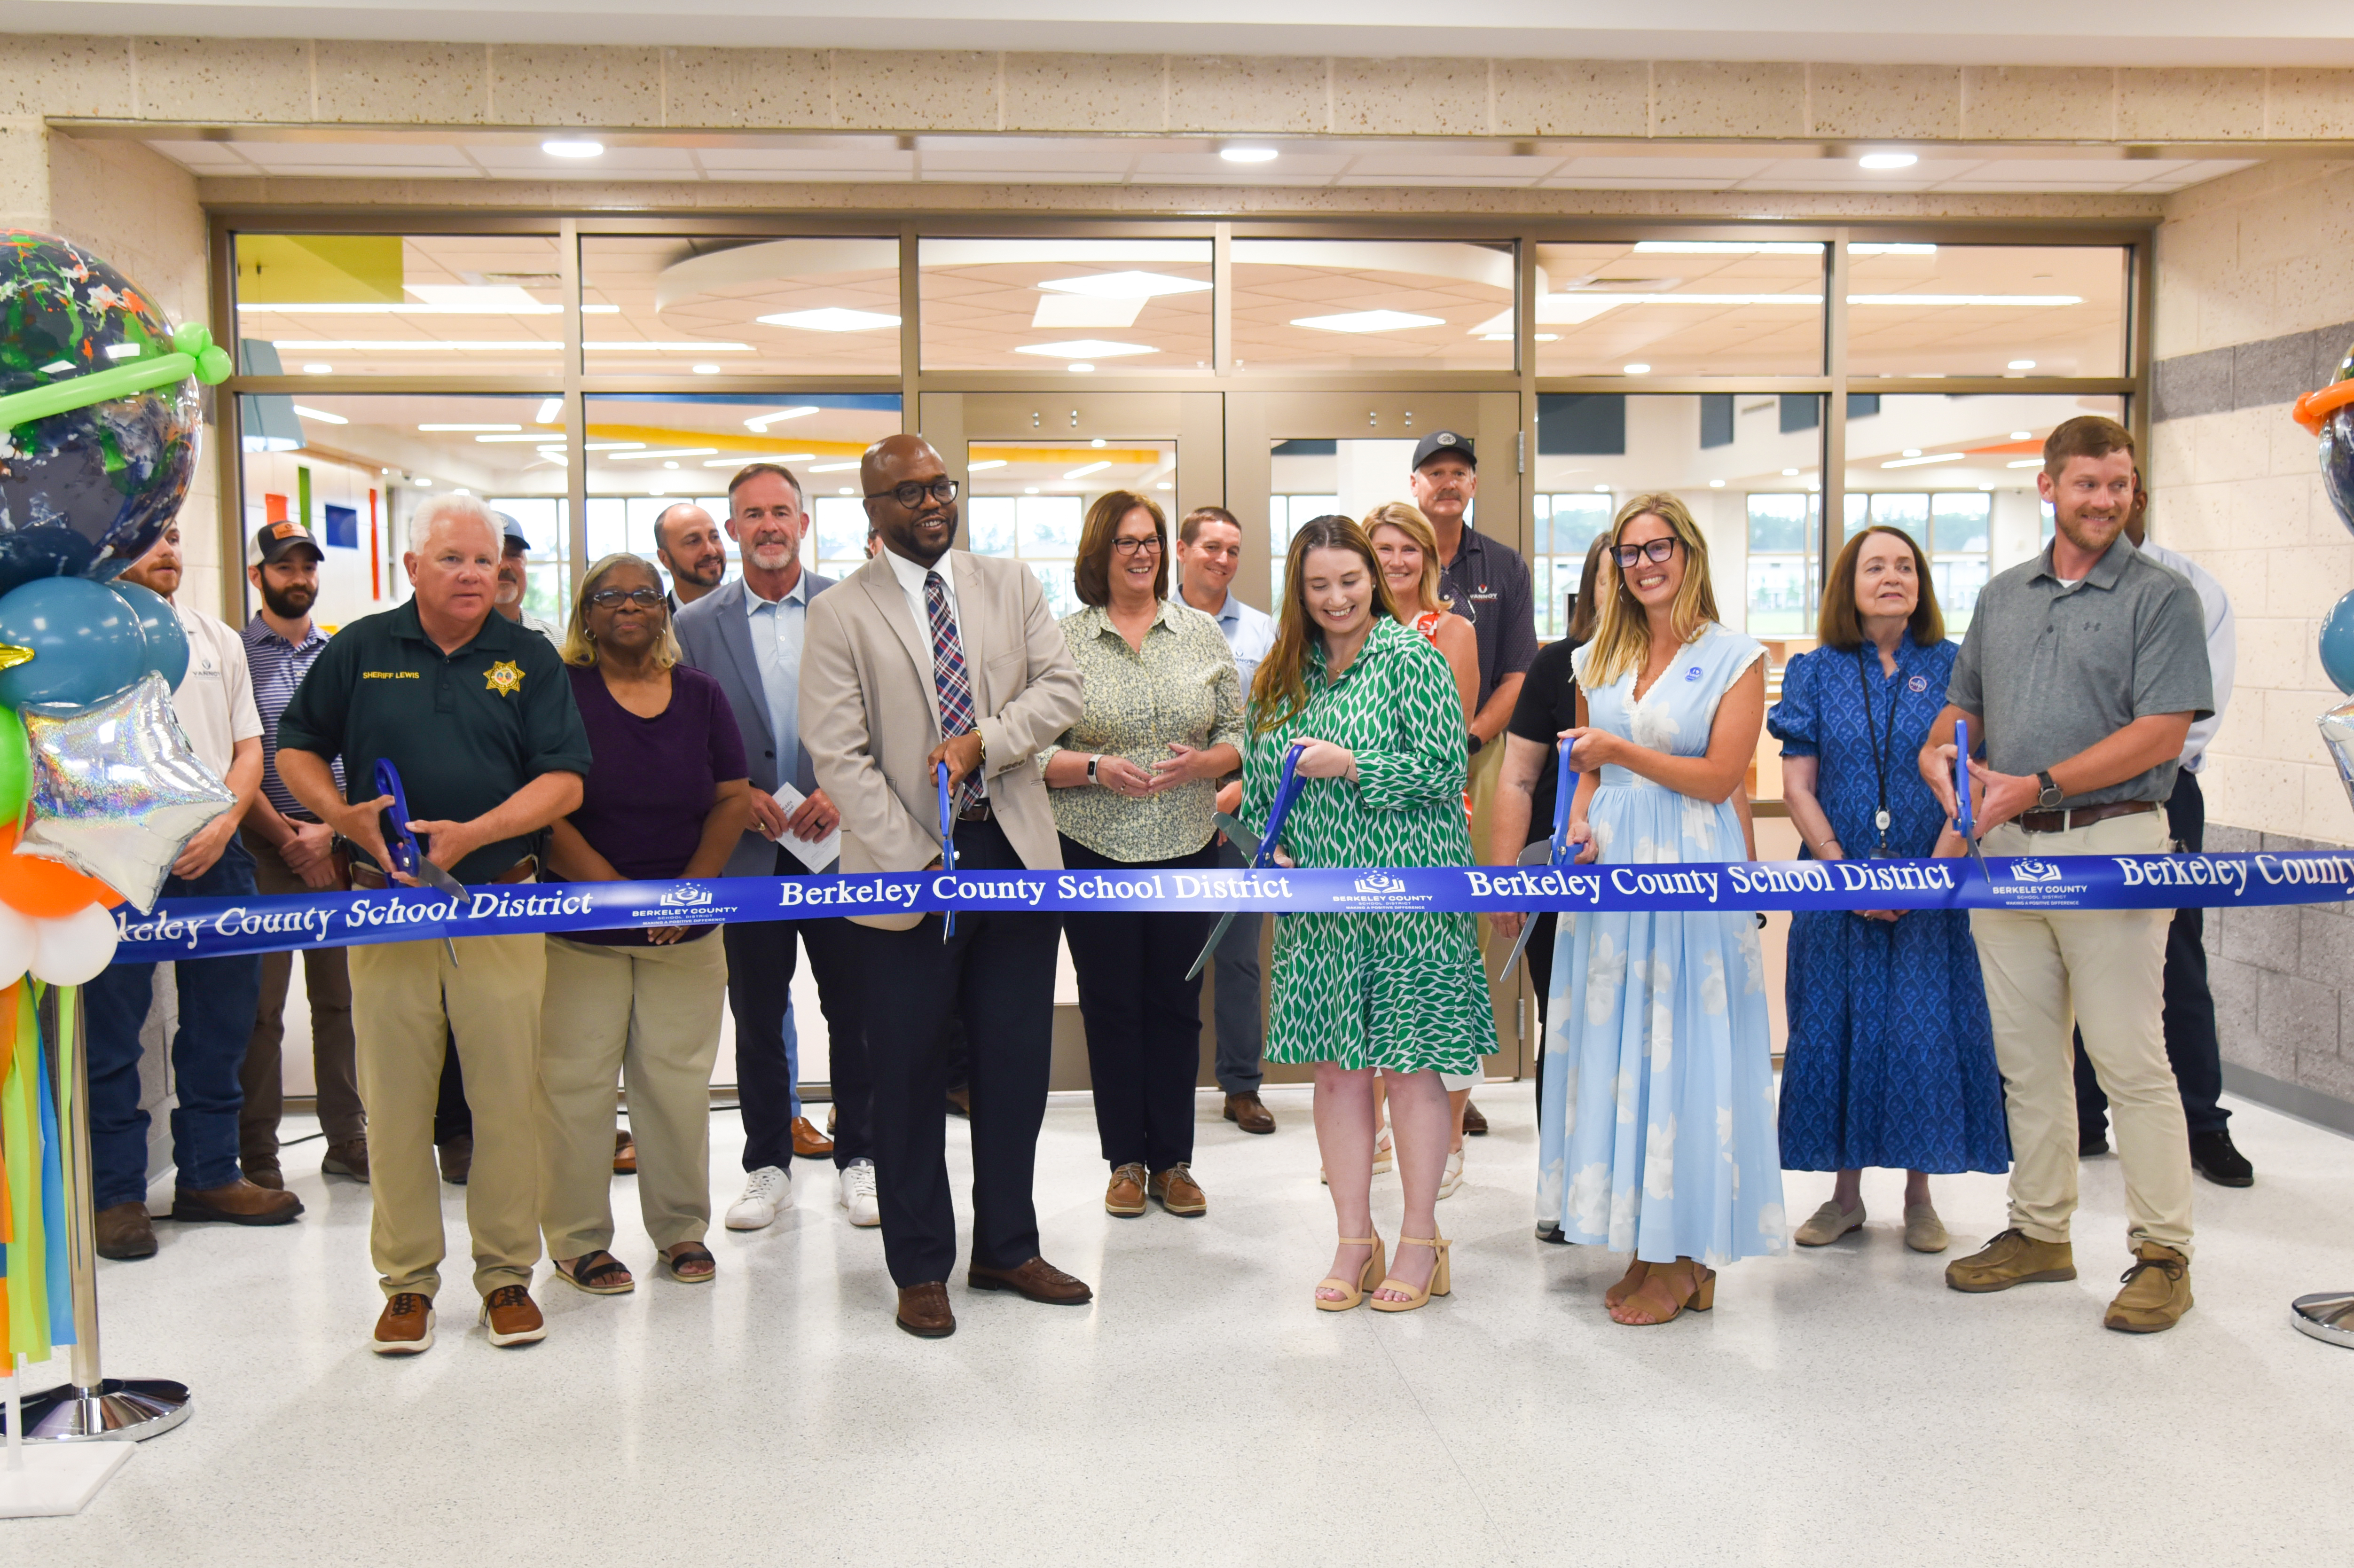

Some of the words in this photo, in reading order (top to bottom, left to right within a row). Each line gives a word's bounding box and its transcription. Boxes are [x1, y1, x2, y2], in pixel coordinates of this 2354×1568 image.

[779, 878, 922, 908] Berkeley
[932, 876, 1046, 906] County
[1058, 875, 1166, 899] School
[1172, 874, 1293, 899] District
[1464, 870, 1600, 904] Berkeley
[1611, 868, 1718, 903] County
[1727, 864, 1835, 894] School
[1835, 862, 1955, 891] District
[2112, 855, 2247, 896] Berkeley
[118, 911, 207, 949] keley
[214, 907, 337, 941] County
[345, 895, 458, 928] School
[468, 890, 595, 919] District
